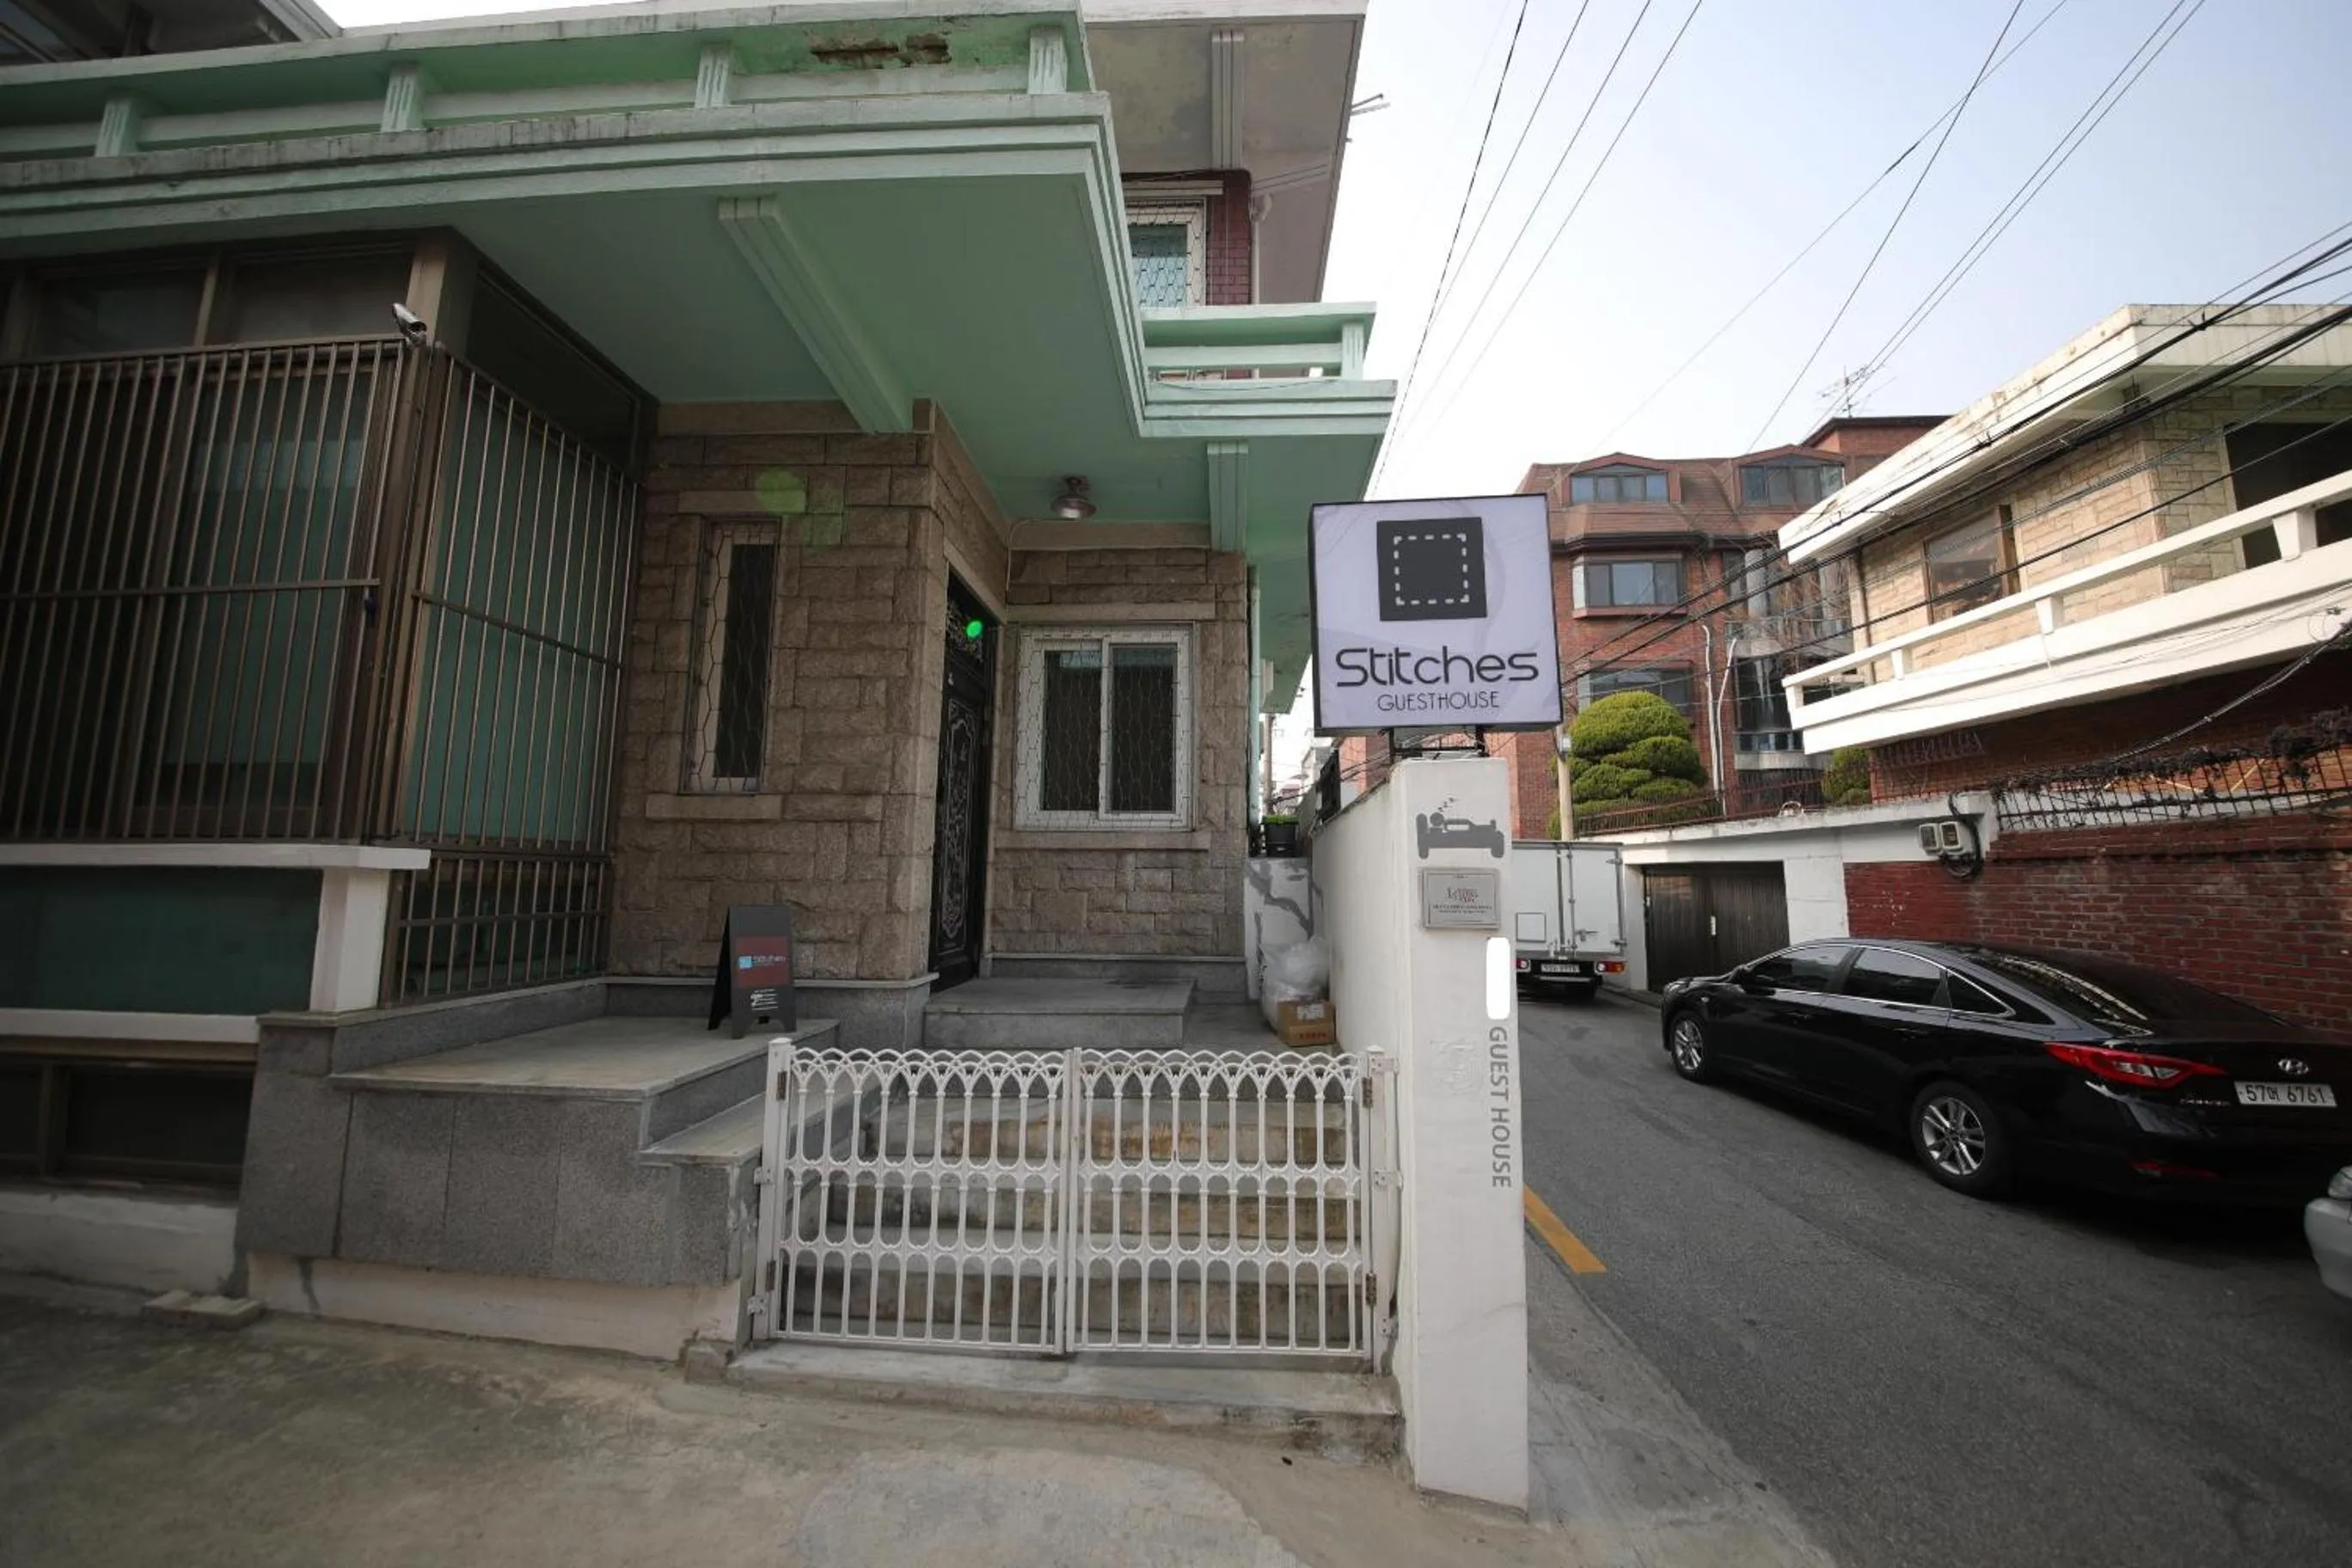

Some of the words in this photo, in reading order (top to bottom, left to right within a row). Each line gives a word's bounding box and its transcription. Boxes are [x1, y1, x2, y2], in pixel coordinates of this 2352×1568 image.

[1335, 646, 1539, 687] Stitches
[1377, 690, 1499, 711] GUESTHOUSE
[1489, 1026, 1509, 1102] GUEST
[2287, 1085, 2326, 1104] 6761
[1491, 1108, 1511, 1188] HOUSE
